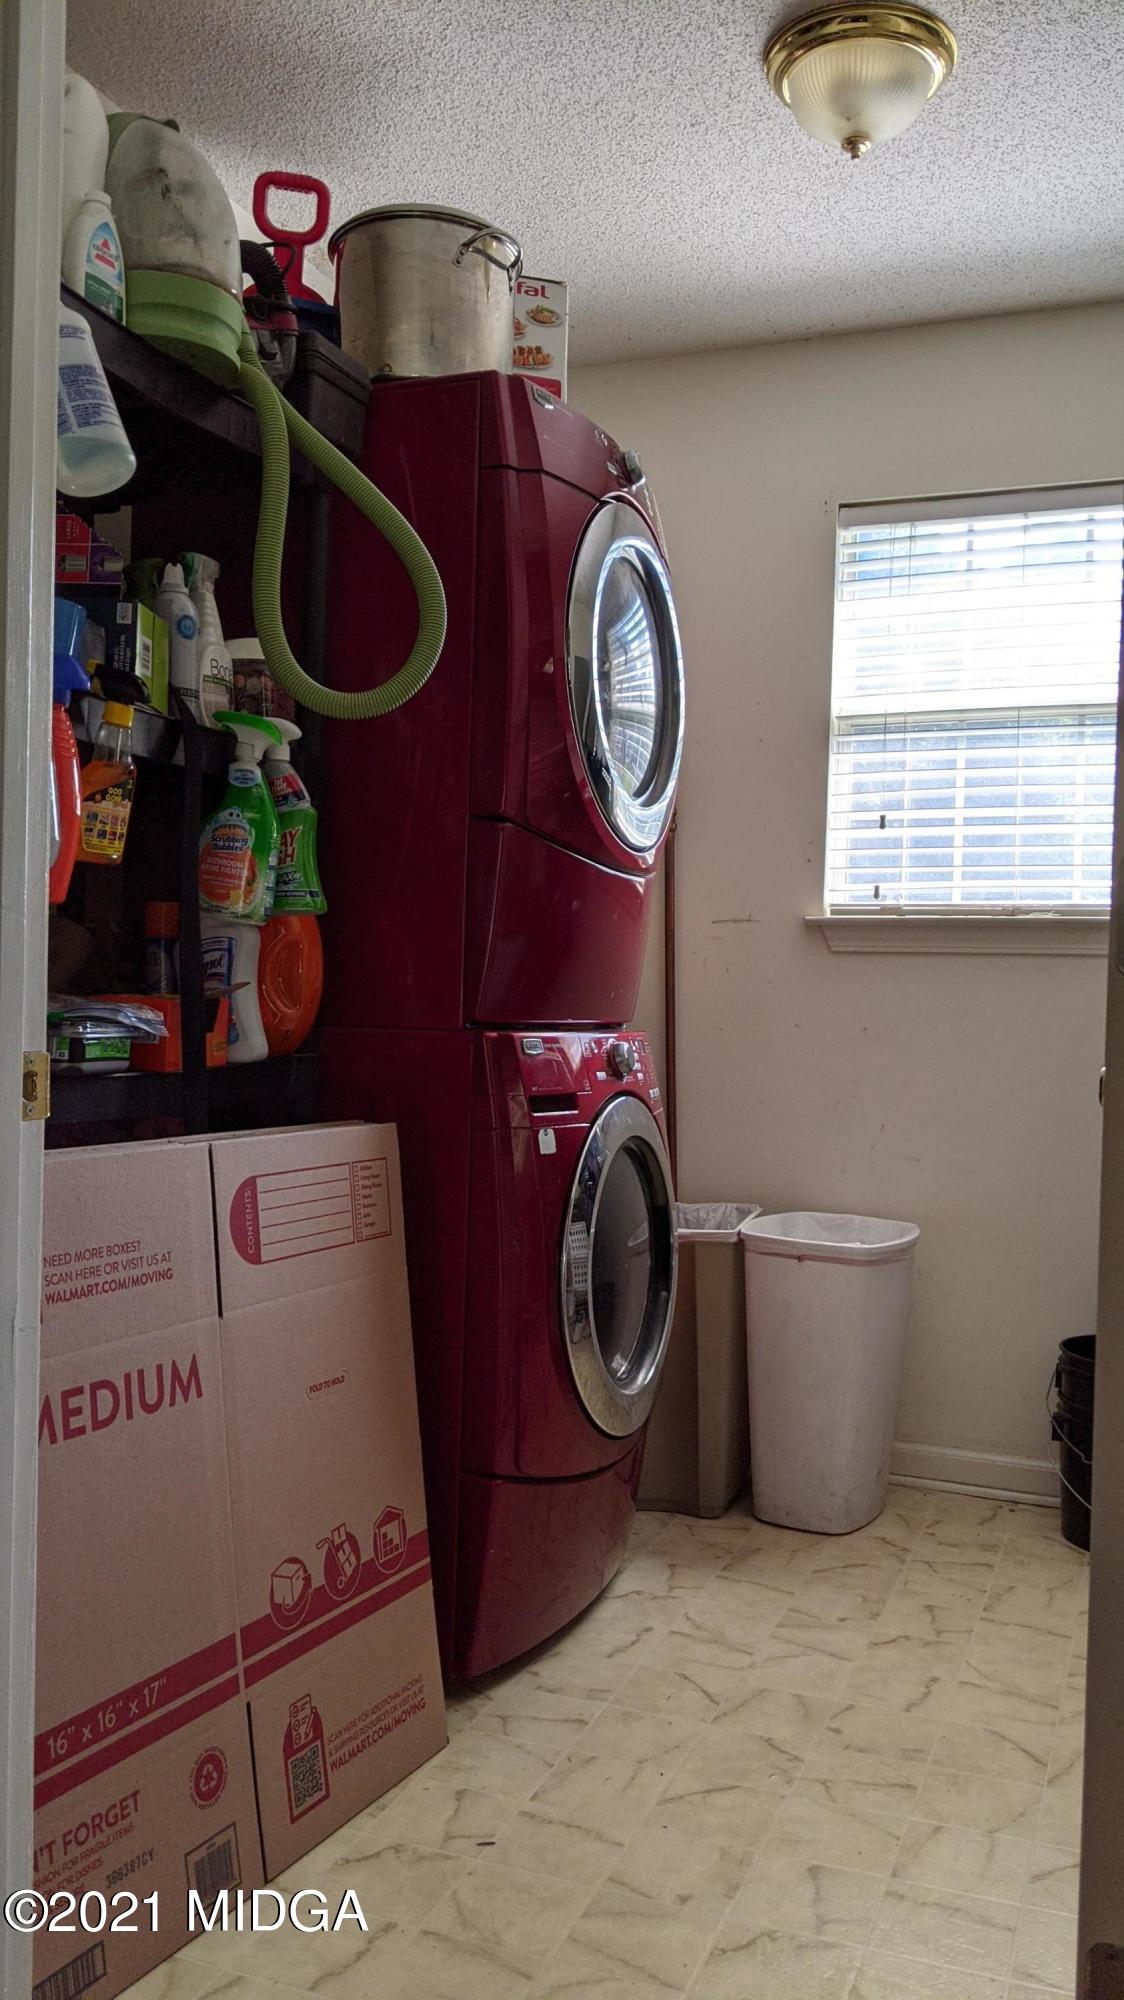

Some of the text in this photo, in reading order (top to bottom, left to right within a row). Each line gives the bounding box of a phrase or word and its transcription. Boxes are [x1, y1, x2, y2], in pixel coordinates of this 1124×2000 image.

[43, 1240, 141, 1268] NEED MORE BOXES?
[44, 1251, 172, 1287] SCAN HERE OR VISIT US AT
[44, 1268, 173, 1306] WALMART.COM/MOVING
[47, 1676, 167, 1759] 16" x 16" x 17"
[330, 1696, 426, 1773] WALMART.COM/MOVING
[62, 1789, 140, 1856] FORGET
[62, 1856, 79, 1872] FOR
